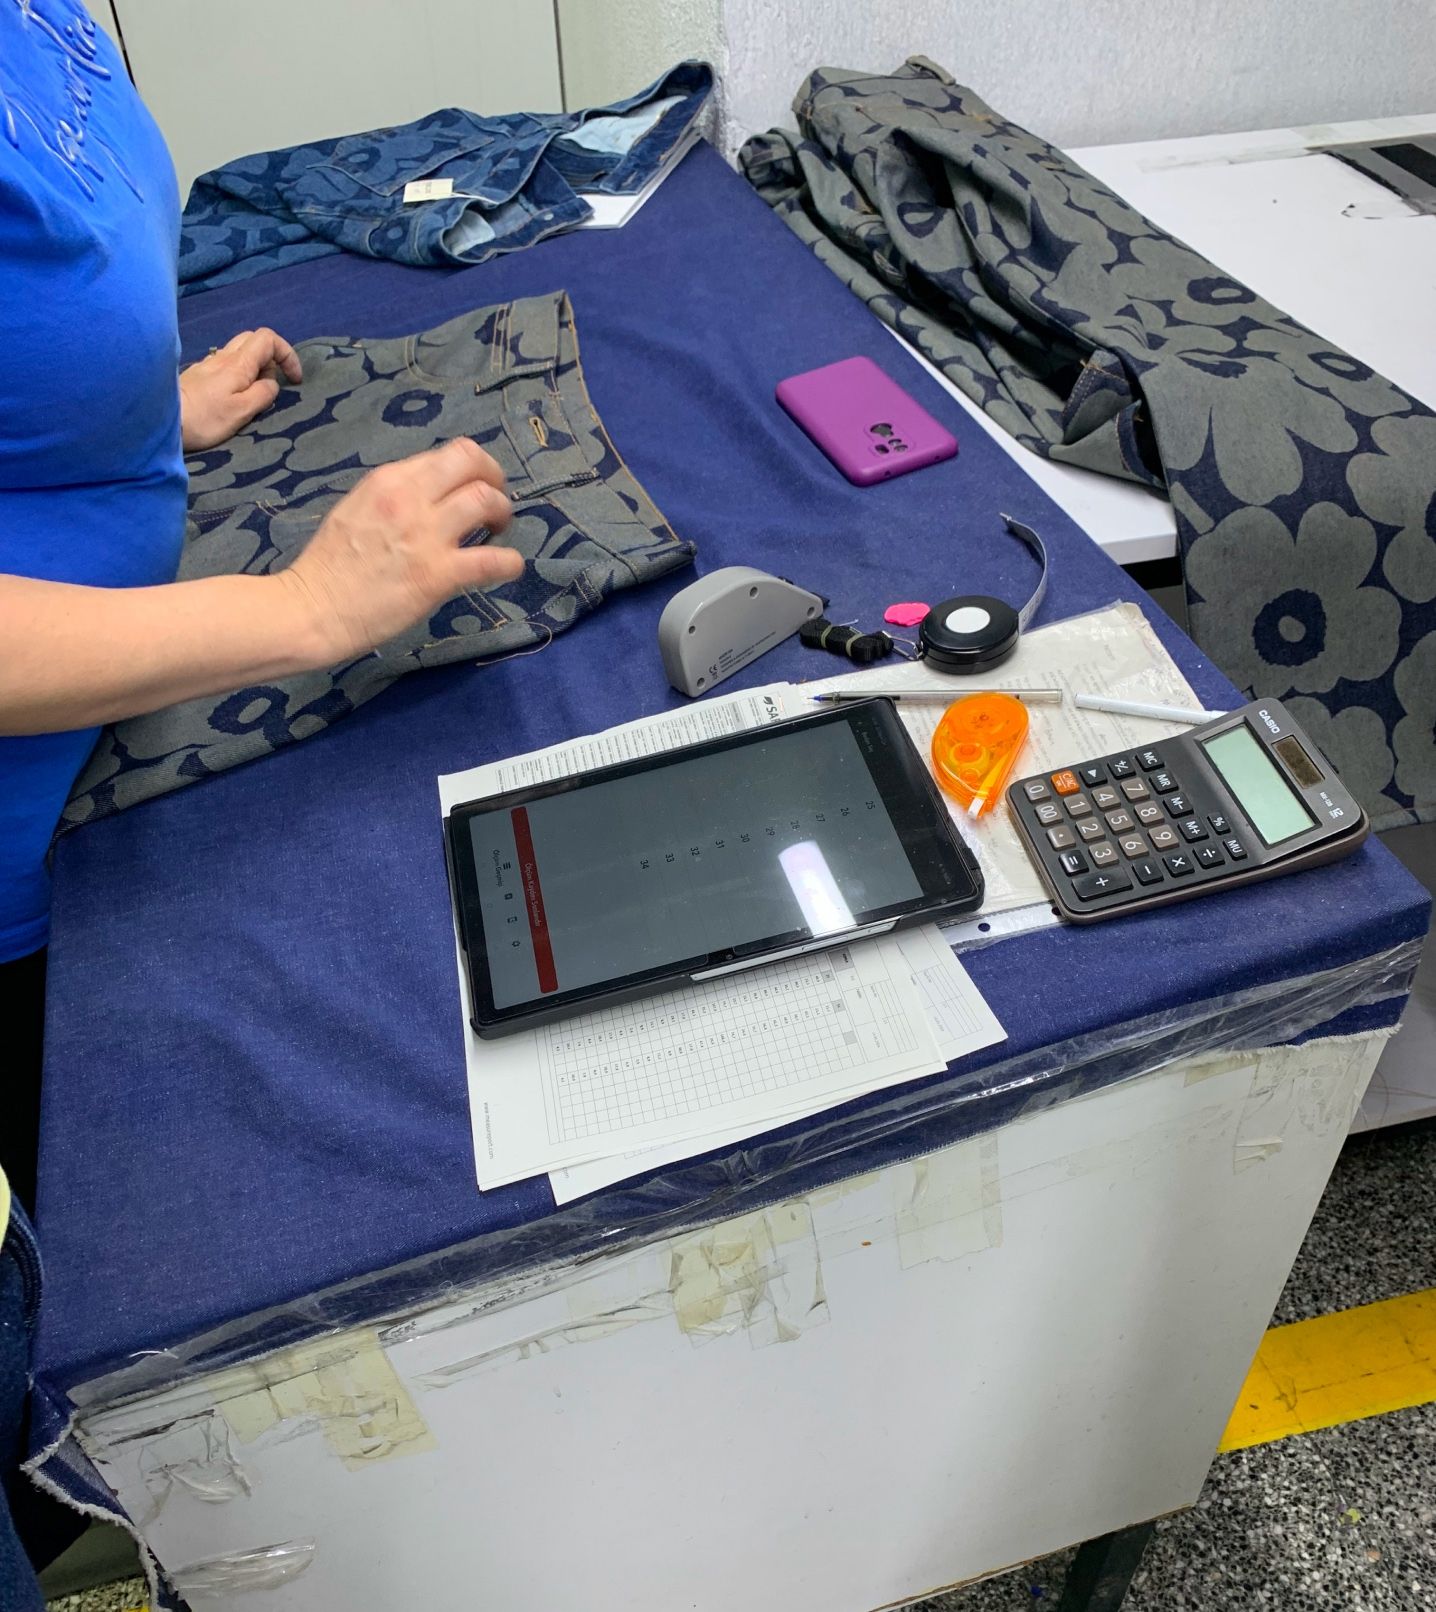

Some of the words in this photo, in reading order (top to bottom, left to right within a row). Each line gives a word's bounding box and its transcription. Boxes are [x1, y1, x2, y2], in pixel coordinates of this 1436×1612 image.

[1258, 709, 1280, 734] CASIO
[1143, 751, 1158, 765] MC
[1156, 774, 1171, 787] MR
[1029, 785, 1044, 794] 0
[1098, 793, 1114, 802] 4
[866, 800, 876, 810] 25
[1070, 801, 1086, 809] 1
[1170, 796, 1184, 810] M-
[840, 807, 850, 816] 26
[1040, 805, 1058, 819] 00
[1140, 808, 1157, 817] 8
[1332, 807, 1344, 819] 12
[816, 813, 826, 822] 27
[1110, 816, 1128, 826] 5
[766, 826, 776, 836] 29
[1082, 824, 1098, 834] 2
[1186, 820, 1200, 835] M+
[740, 833, 750, 843] 30
[1154, 831, 1172, 840] 9
[715, 840, 725, 848] 31
[1125, 841, 1142, 850] 6
[1227, 839, 1243, 853] MU
[690, 846, 700, 856] 32
[1094, 848, 1112, 858] 3
[666, 853, 675, 863] 33
[640, 860, 650, 870] 34
